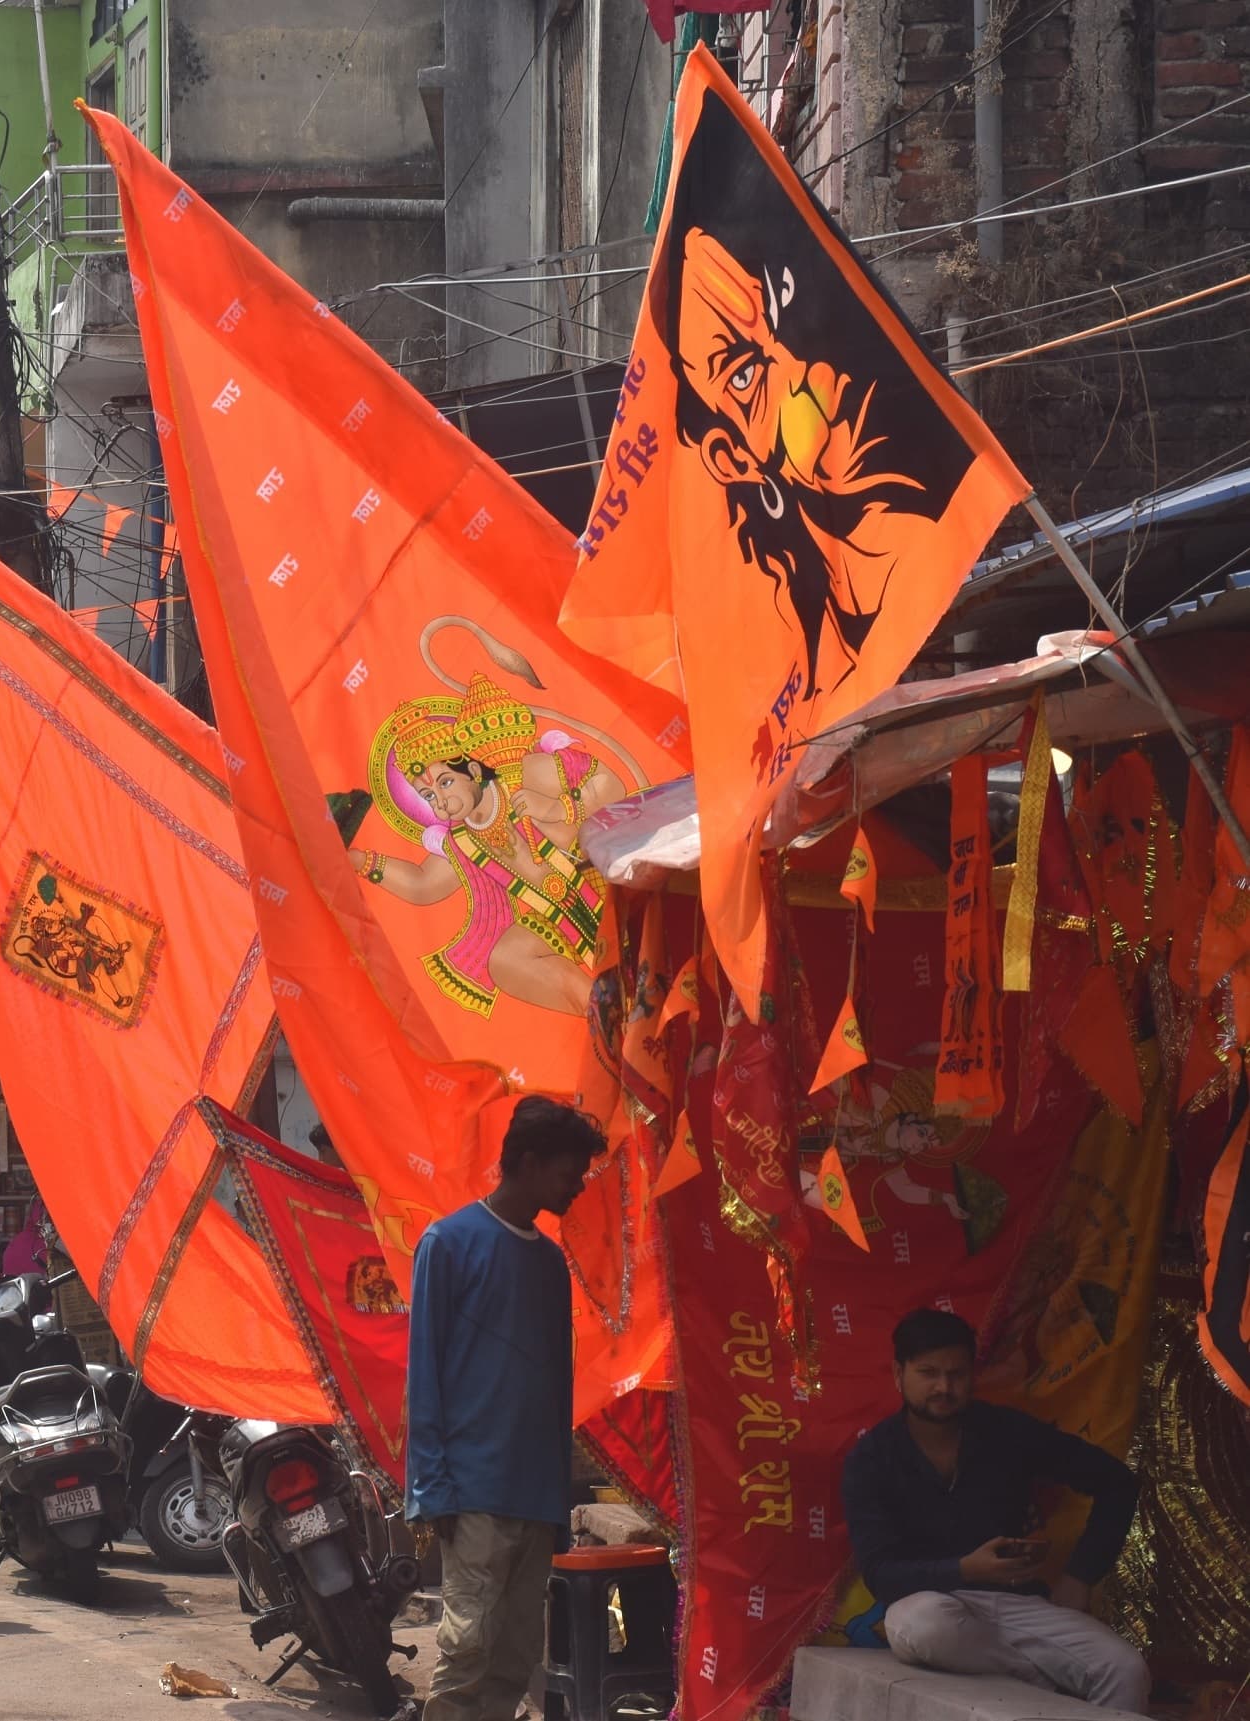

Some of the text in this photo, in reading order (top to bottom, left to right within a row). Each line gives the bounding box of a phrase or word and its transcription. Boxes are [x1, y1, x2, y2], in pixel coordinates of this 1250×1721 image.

[163, 187, 194, 222] राम
[216, 298, 247, 333] राम
[341, 398, 372, 432] राम
[461, 506, 493, 541] राम
[655, 715, 687, 750] राम
[953, 836, 975, 858] जय
[259, 876, 288, 906] राम
[271, 975, 303, 1003] राम
[425, 1068, 457, 1097] राम
[406, 1153, 435, 1182] राम
[893, 1231, 911, 1264] राम
[832, 1303, 852, 1336] राम
[722, 1311, 801, 1535] जय श्री राम
[54, 1490, 92, 1507] JH09B
[809, 1506, 825, 1541] राम
[747, 1585, 767, 1621] राम
[699, 1645, 718, 1685] राम
